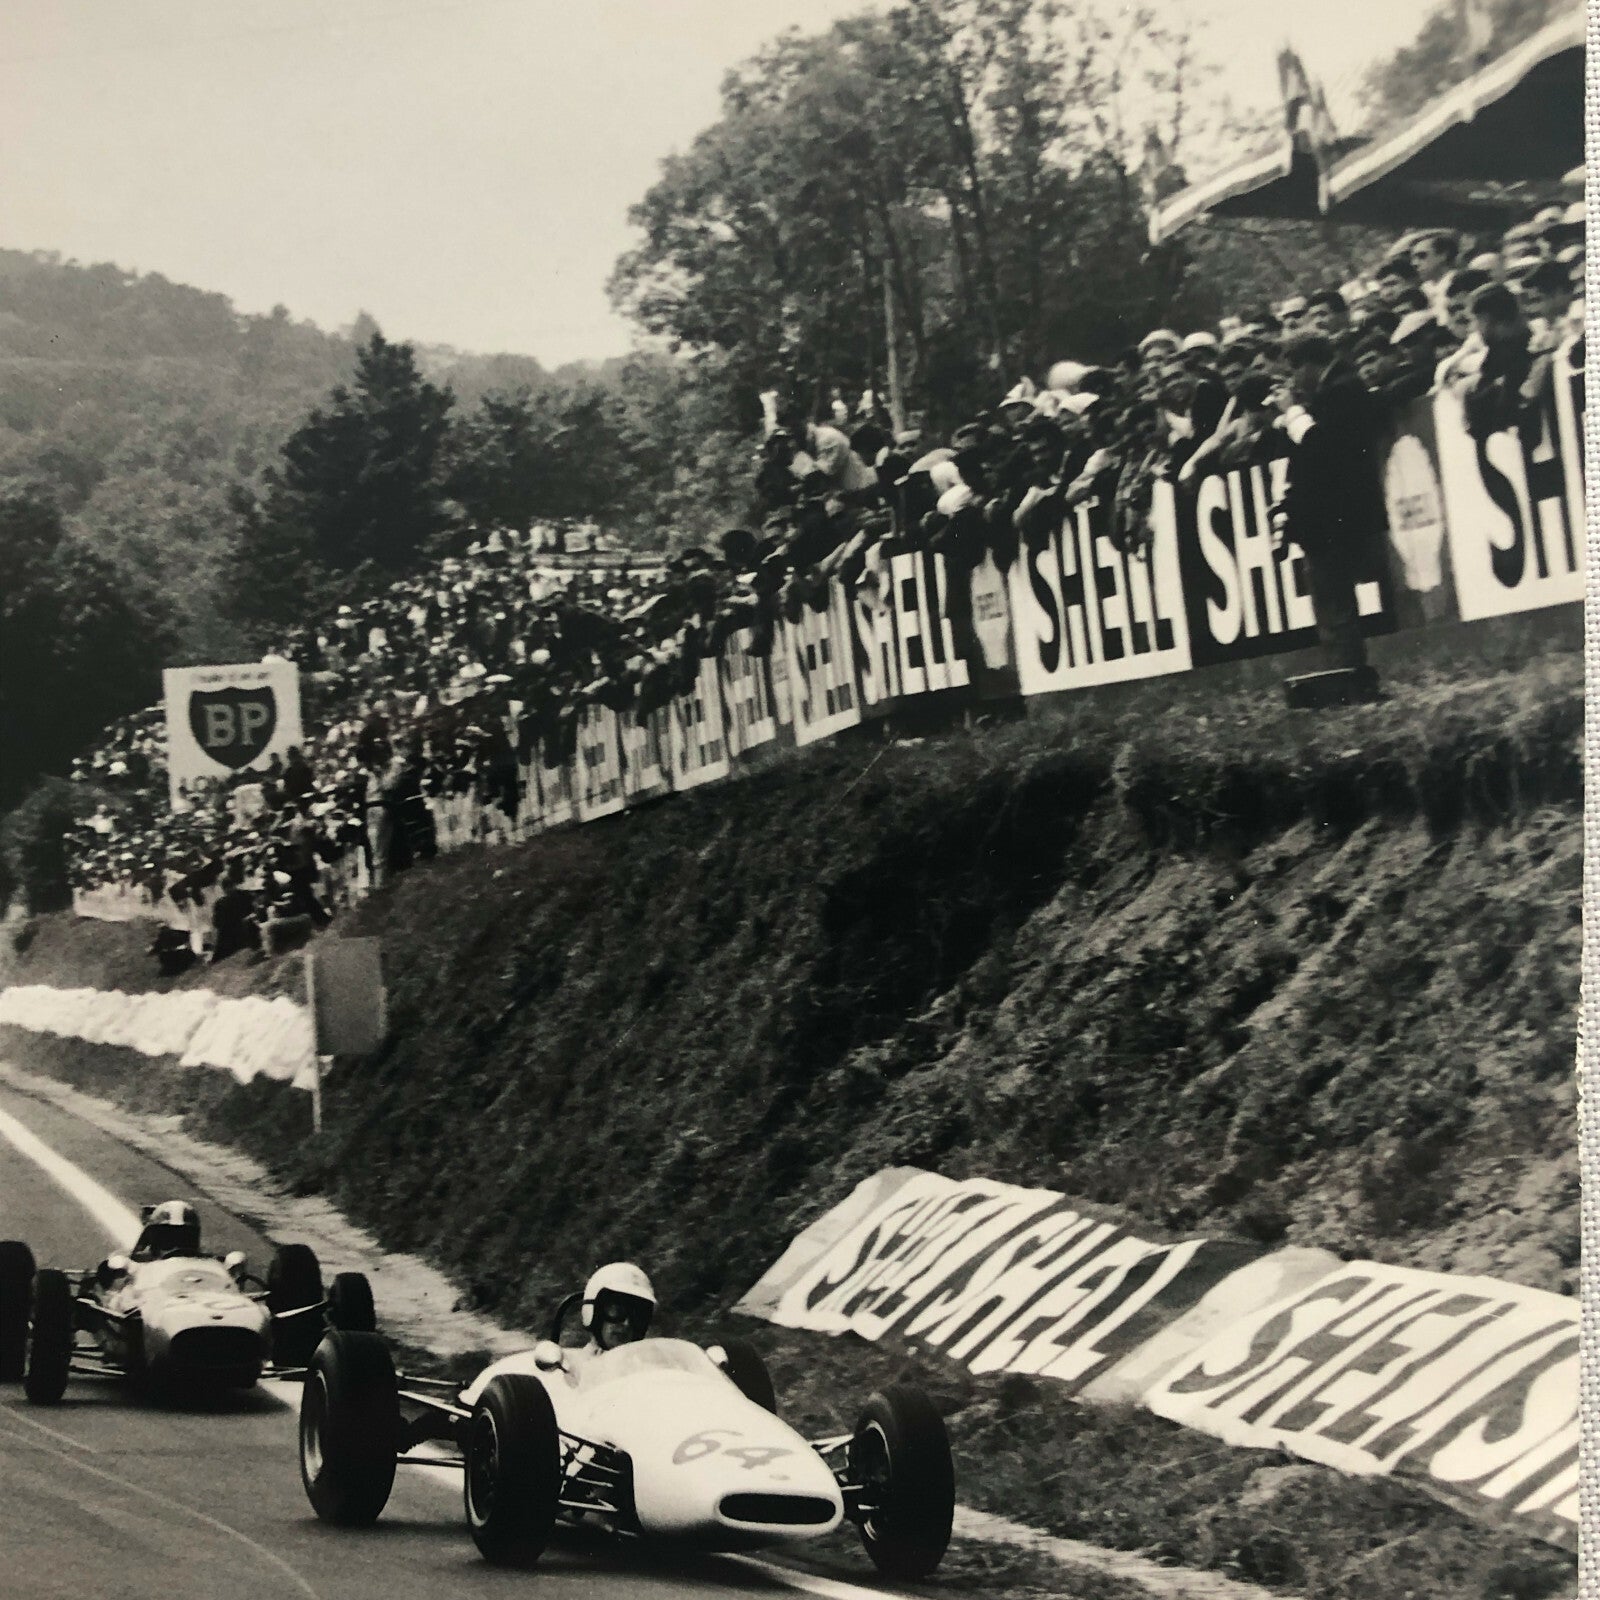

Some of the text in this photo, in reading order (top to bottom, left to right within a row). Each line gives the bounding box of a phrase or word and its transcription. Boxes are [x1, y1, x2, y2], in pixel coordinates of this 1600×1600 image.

[1476, 372, 1586, 589] SH
[854, 551, 970, 705] SHELL
[1027, 503, 1176, 674] SHELL
[203, 702, 270, 747] BP
[904, 1211, 1207, 1381] SHELL
[1169, 1275, 1578, 1461] SHELL
[672, 1429, 794, 1480] 64
